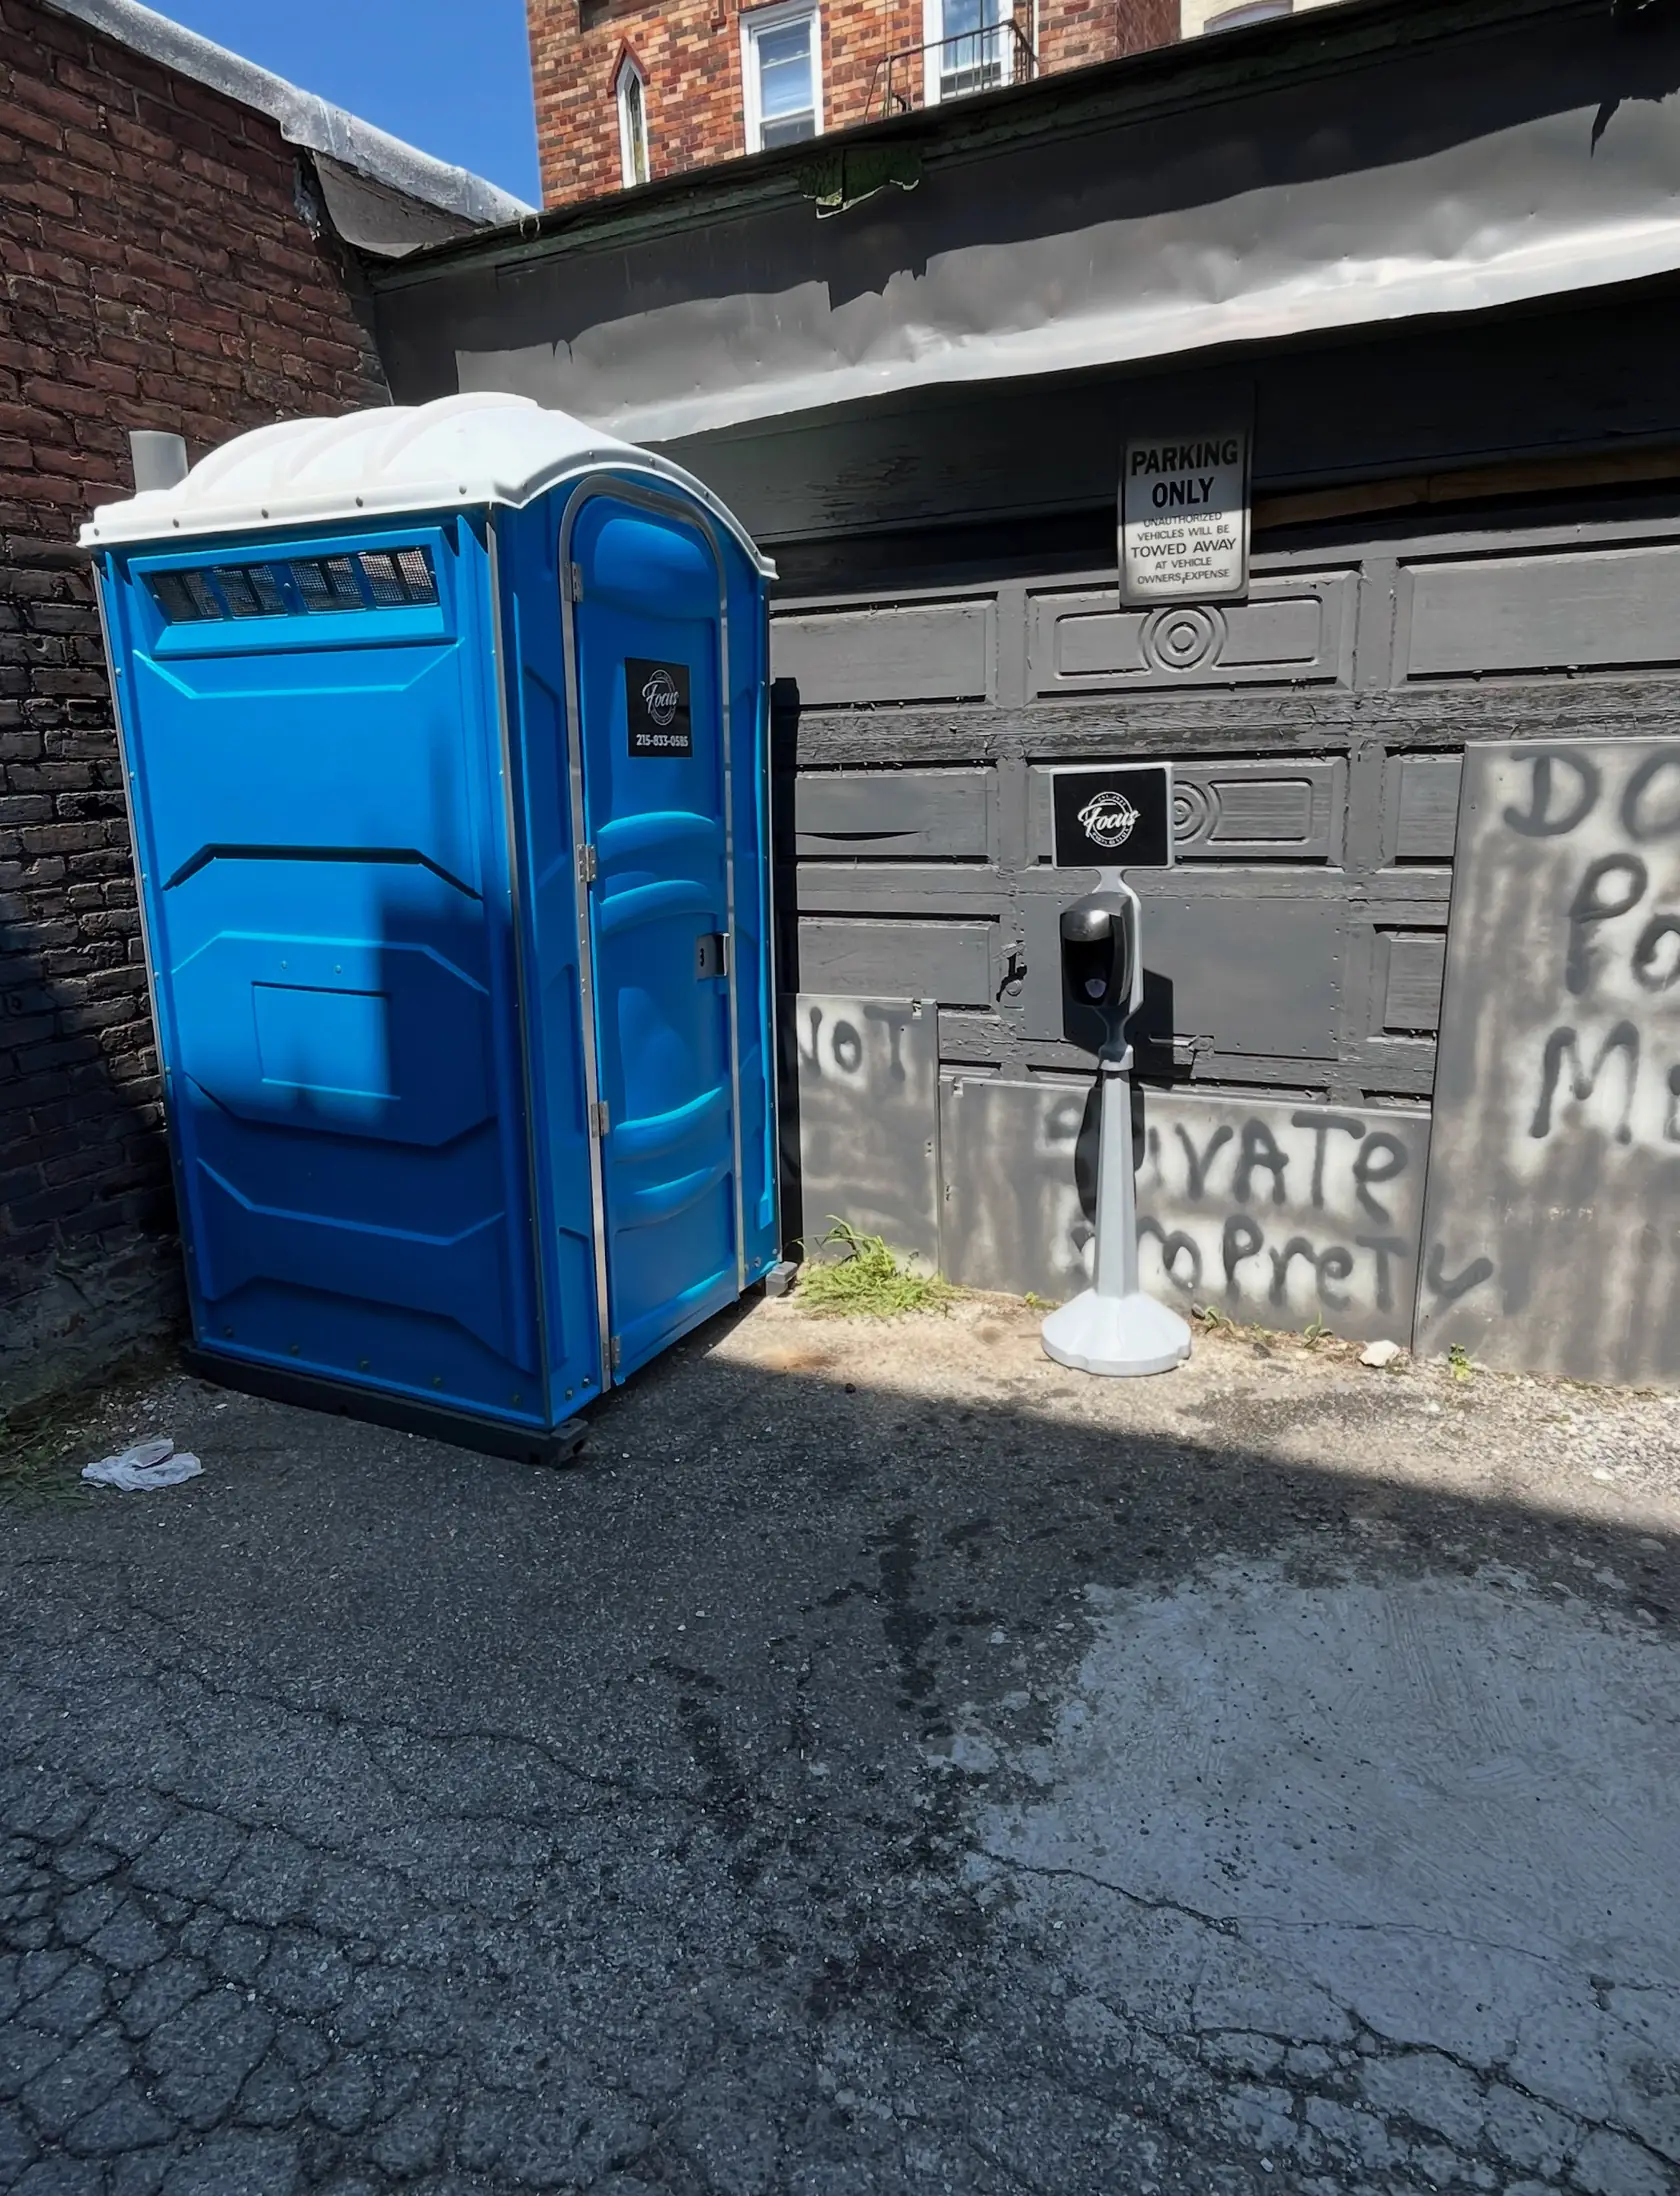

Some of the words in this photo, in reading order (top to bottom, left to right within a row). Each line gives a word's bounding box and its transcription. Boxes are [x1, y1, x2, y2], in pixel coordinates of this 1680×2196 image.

[1131, 439, 1238, 476] PARKING
[1152, 477, 1214, 508] ONLY
[1143, 512, 1222, 528] UNAUTHORIZED
[1137, 529, 1185, 542] VEHICLES
[1188, 526, 1212, 537] WILL
[1217, 524, 1230, 535] BE
[1131, 542, 1187, 559] TOWED
[1193, 538, 1237, 553] AWAY
[1155, 560, 1168, 570] AT
[1171, 557, 1212, 570] VEHICLE
[1185, 569, 1230, 581] EXPENSE
[642, 680, 680, 714] Focus
[1077, 802, 1141, 838] Focus
